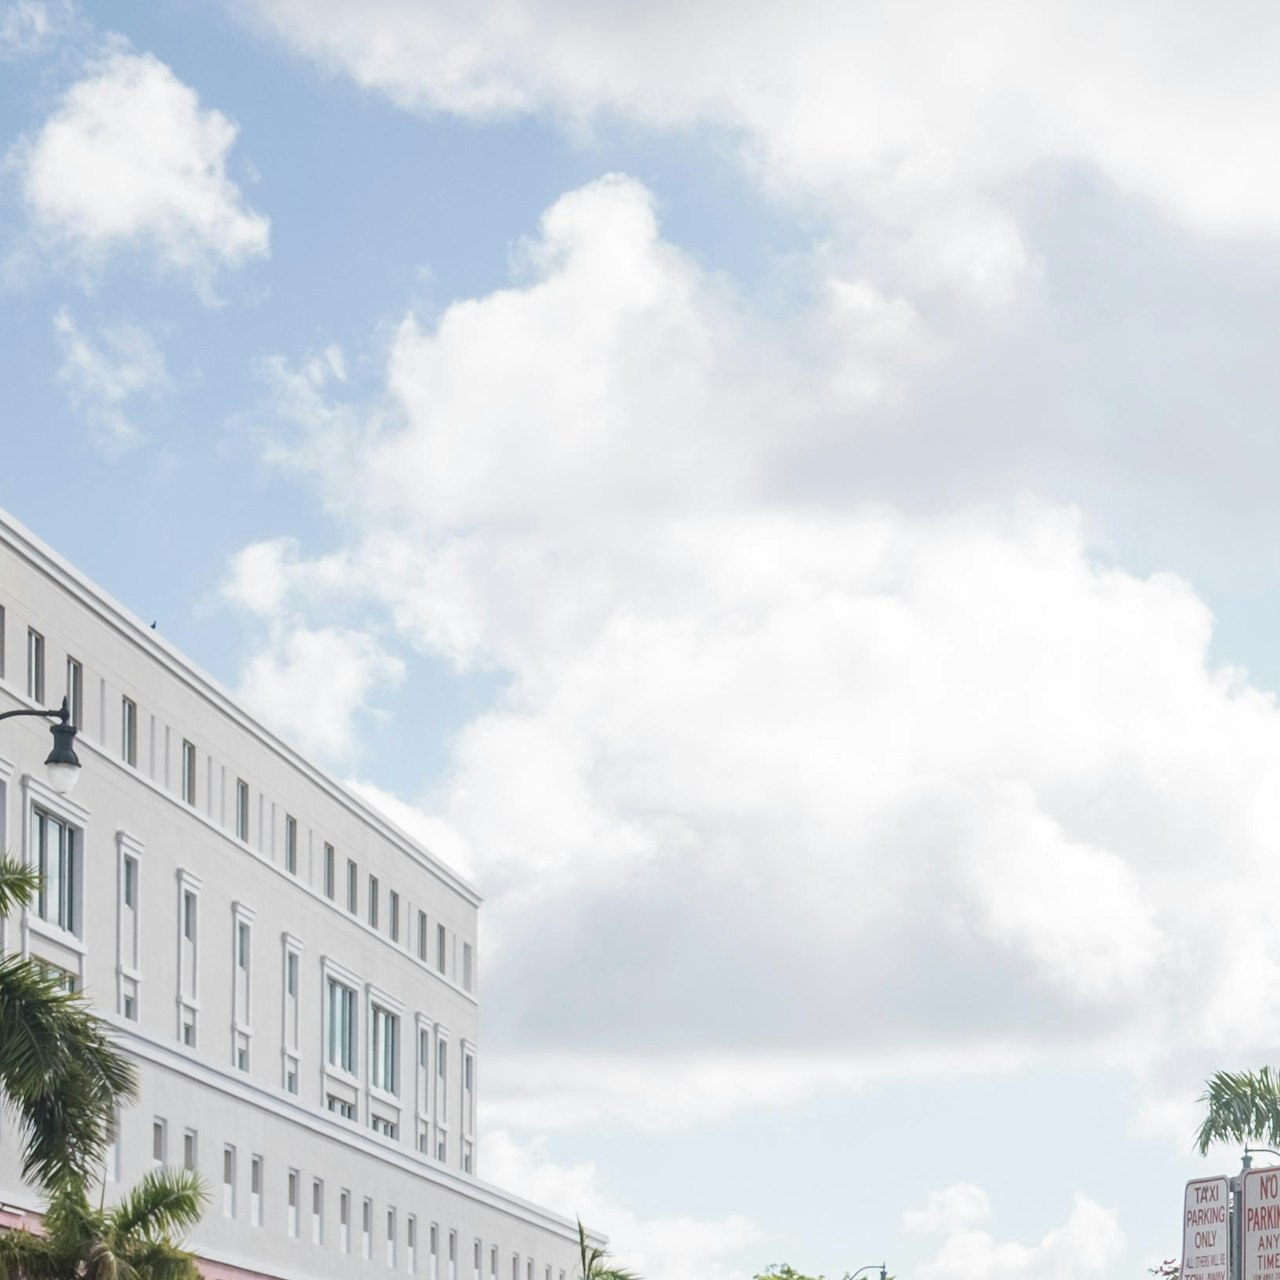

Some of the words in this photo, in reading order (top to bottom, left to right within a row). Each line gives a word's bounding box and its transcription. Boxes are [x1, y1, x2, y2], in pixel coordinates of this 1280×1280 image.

[1195, 1185, 1219, 1204] TAXI
[1260, 1174, 1279, 1201] NO
[1186, 1206, 1226, 1227] PARKING
[1194, 1231, 1217, 1249] ONLY
[1258, 1234, 1280, 1251] ANY
[1257, 1253, 1280, 1270] TIME
